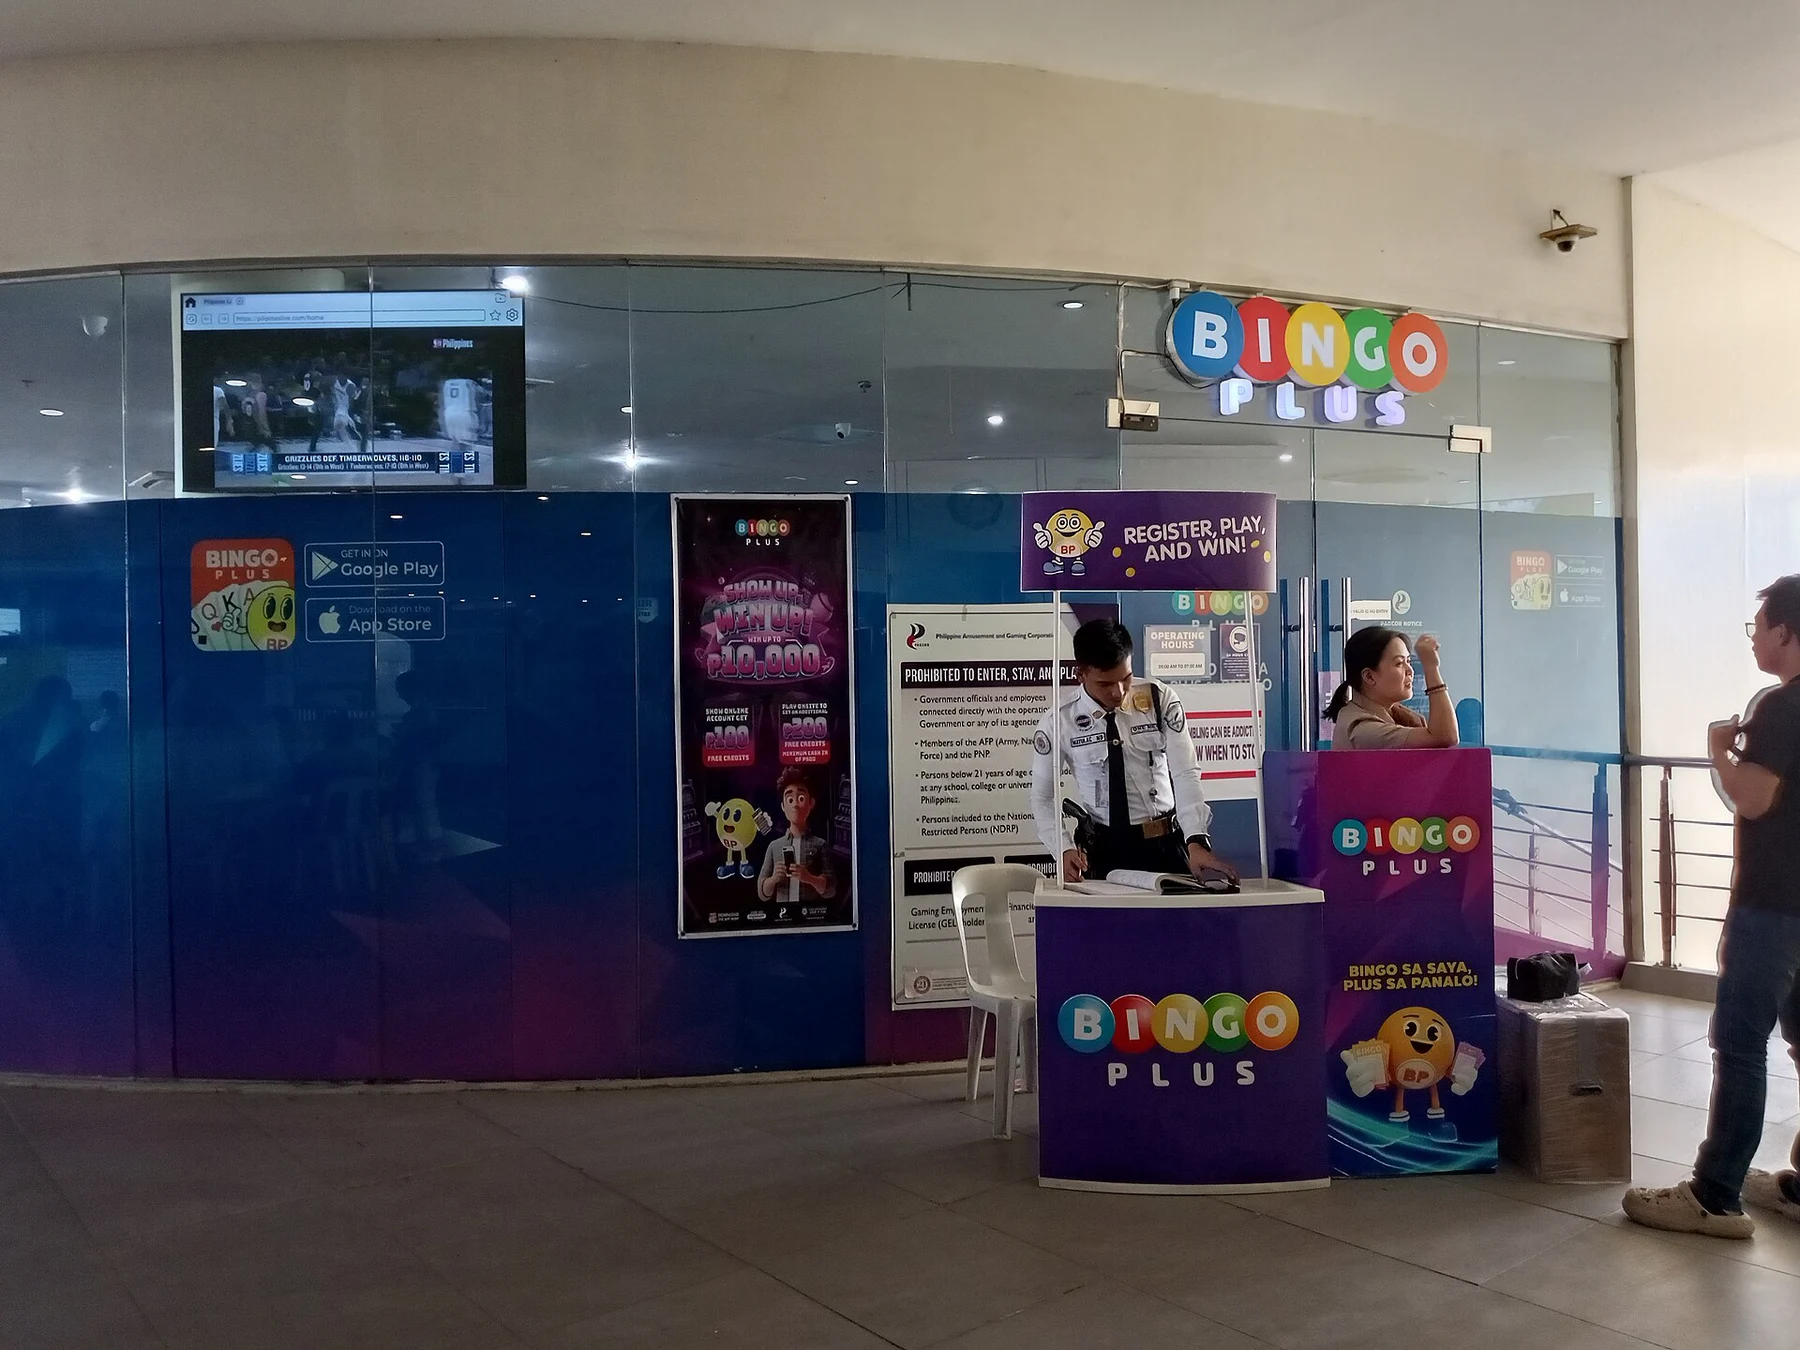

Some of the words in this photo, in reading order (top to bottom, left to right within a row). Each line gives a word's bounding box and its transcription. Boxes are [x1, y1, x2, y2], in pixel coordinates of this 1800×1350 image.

[442, 338, 474, 350] Philippines
[1192, 310, 1438, 378] BINGO
[1219, 377, 1406, 427] PLUS
[738, 521, 788, 534] BINGO
[1124, 518, 1218, 544] REGISTER,
[1220, 515, 1266, 536] PLAY,
[746, 538, 780, 546] PLUS
[340, 549, 359, 558] GET
[1060, 545, 1076, 555] BP
[1144, 542, 1192, 563] AND
[1198, 536, 1247, 557] WIN!
[205, 548, 279, 568] BINGO
[1516, 556, 1545, 566] BINGO
[215, 568, 270, 580] PLUS
[340, 562, 398, 578] Google
[404, 562, 438, 578] Play
[1568, 566, 1589, 575] Google
[724, 580, 772, 604] SHOW
[1178, 594, 1264, 610] BINGO
[1571, 595, 1584, 603] App
[349, 605, 397, 614] Downoad
[415, 604, 431, 613] the
[348, 618, 383, 634] App
[387, 617, 432, 631] Store
[714, 604, 765, 636] WIN
[770, 604, 814, 636] UP!
[1150, 631, 1205, 640] OPERATING
[1161, 640, 1195, 649] HOURS
[905, 668, 960, 682] PROHIBITED
[962, 668, 975, 682] TO
[978, 667, 1010, 682] ENTER,
[1012, 667, 1036, 682] STAY,
[1060, 666, 1078, 680] PLA
[920, 696, 964, 704] Government
[1010, 695, 1046, 704] employees
[919, 707, 957, 716] connected
[959, 707, 985, 717] directly
[987, 706, 1003, 715] with
[920, 720, 964, 728] Government
[977, 721, 989, 729] any
[1188, 727, 1209, 739] MBLING
[1210, 726, 1222, 738] CAN
[1223, 726, 1231, 737] BE
[920, 739, 953, 748] Members
[956, 738, 964, 747] of
[967, 738, 977, 746] the
[979, 738, 994, 746] AFP
[996, 737, 1019, 747] (Army,
[920, 751, 943, 760] Force)
[945, 751, 958, 759] and
[1205, 745, 1228, 761] WHEN
[1230, 744, 1240, 760] TO
[1242, 744, 1256, 760] STO
[921, 771, 949, 779] Persons
[951, 770, 973, 779] below
[985, 771, 1004, 780] years
[1015, 771, 1028, 779] age
[930, 784, 942, 793] any
[944, 783, 970, 792] school,
[971, 782, 996, 792] college
[921, 816, 950, 824] Persons
[952, 814, 981, 823] included
[921, 828, 958, 836] Restricted
[990, 825, 1019, 835] (NDRP)
[1342, 824, 1472, 848] BINGO
[723, 839, 738, 848] BP
[1362, 858, 1452, 876] PLUS
[910, 907, 939, 917] Gaming
[909, 921, 936, 930] License
[938, 919, 957, 930] (GEL
[1349, 964, 1398, 977] BINGO
[1402, 963, 1422, 976] SA
[1427, 961, 1472, 975] SAYA,
[1343, 978, 1382, 991] PLUS
[1386, 978, 1407, 990] SA
[1411, 975, 1478, 988] PANALO!
[1073, 1004, 1287, 1041] BINGO
[1108, 1060, 1256, 1087] PLUS
[1403, 1068, 1430, 1083] BP
